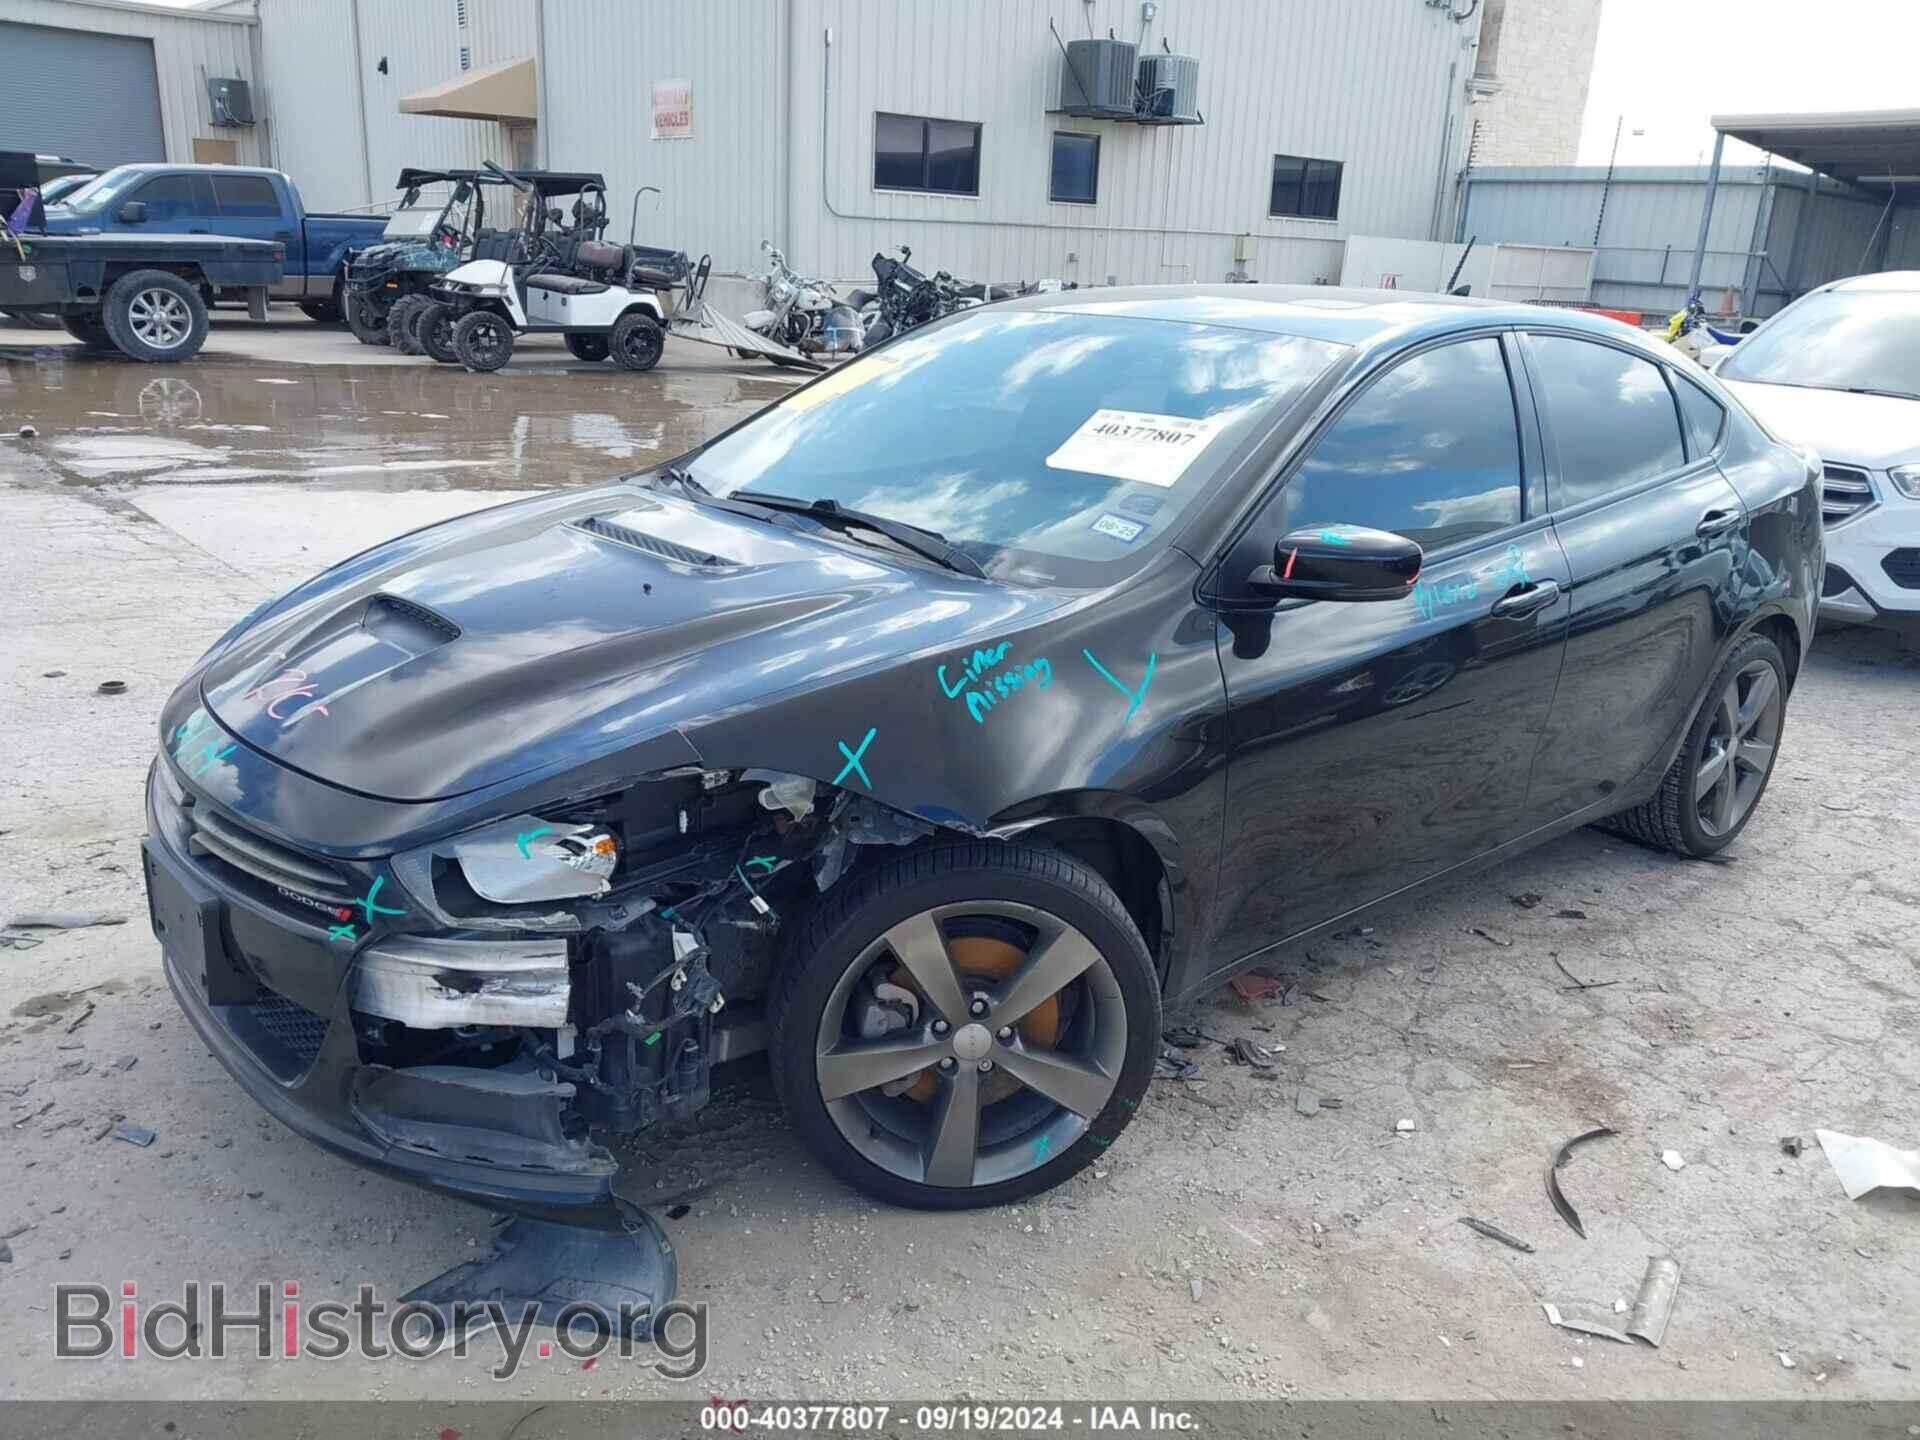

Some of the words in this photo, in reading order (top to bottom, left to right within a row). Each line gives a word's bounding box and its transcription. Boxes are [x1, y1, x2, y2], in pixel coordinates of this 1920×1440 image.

[654, 111, 689, 128] VEHICLES
[1093, 423, 1197, 446] 40377807
[278, 886, 340, 916] DODGE
